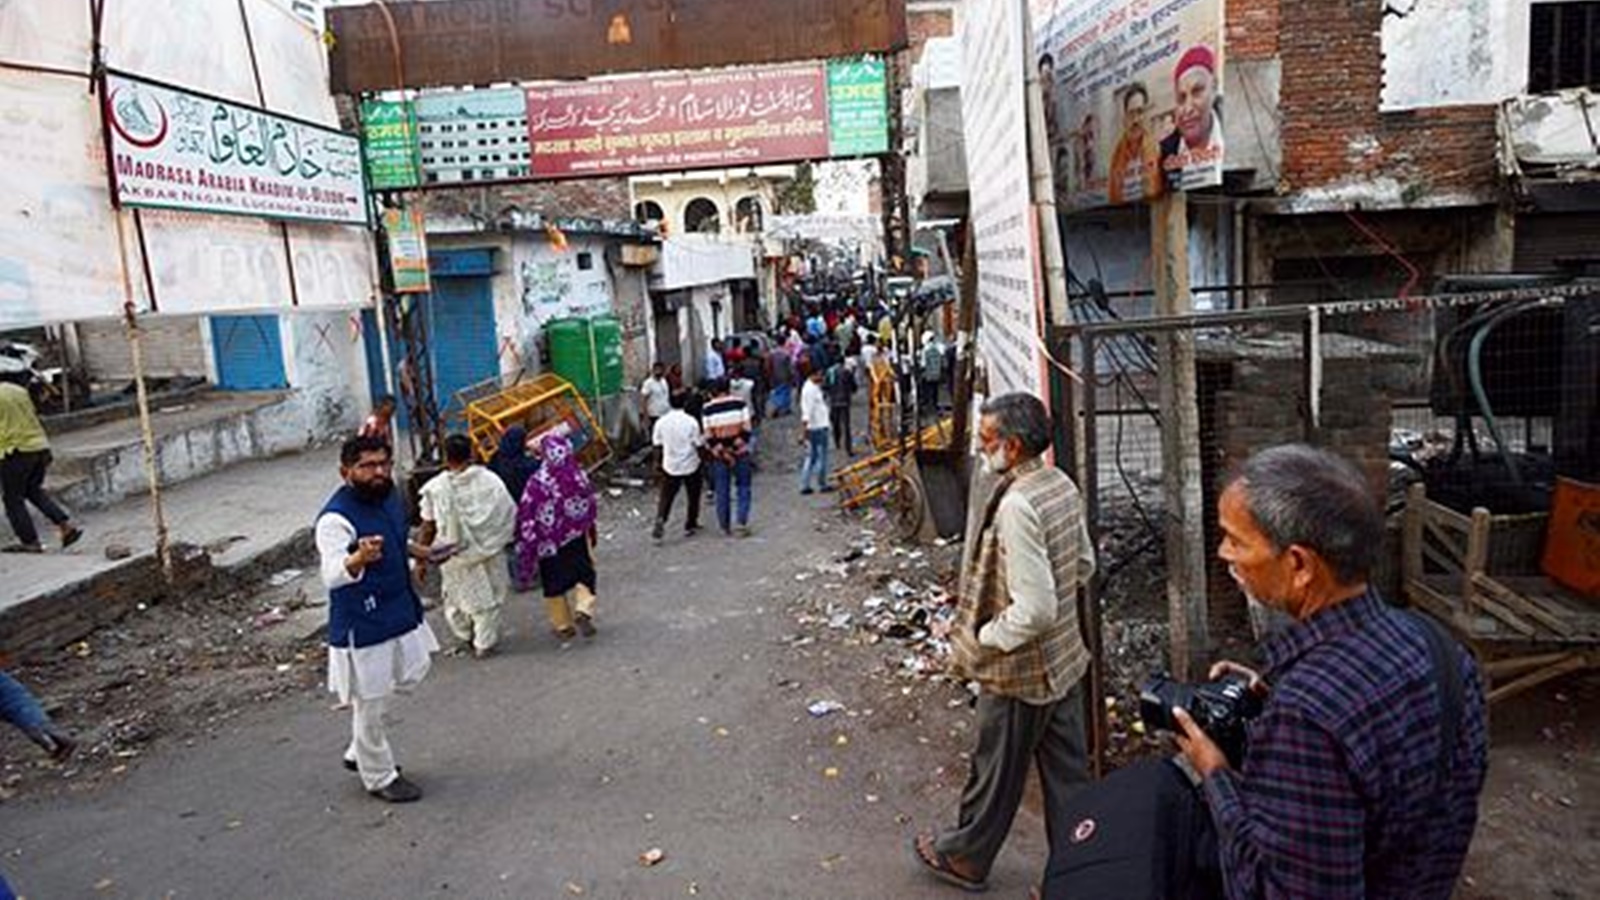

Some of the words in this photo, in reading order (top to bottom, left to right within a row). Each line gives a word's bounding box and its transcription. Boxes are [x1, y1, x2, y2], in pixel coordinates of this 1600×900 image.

[207, 103, 269, 166] العلوم
[270, 122, 322, 179] خادم
[116, 153, 195, 186] MADRASA
[198, 168, 246, 193] ARABIA
[118, 182, 179, 200] AKBAR
